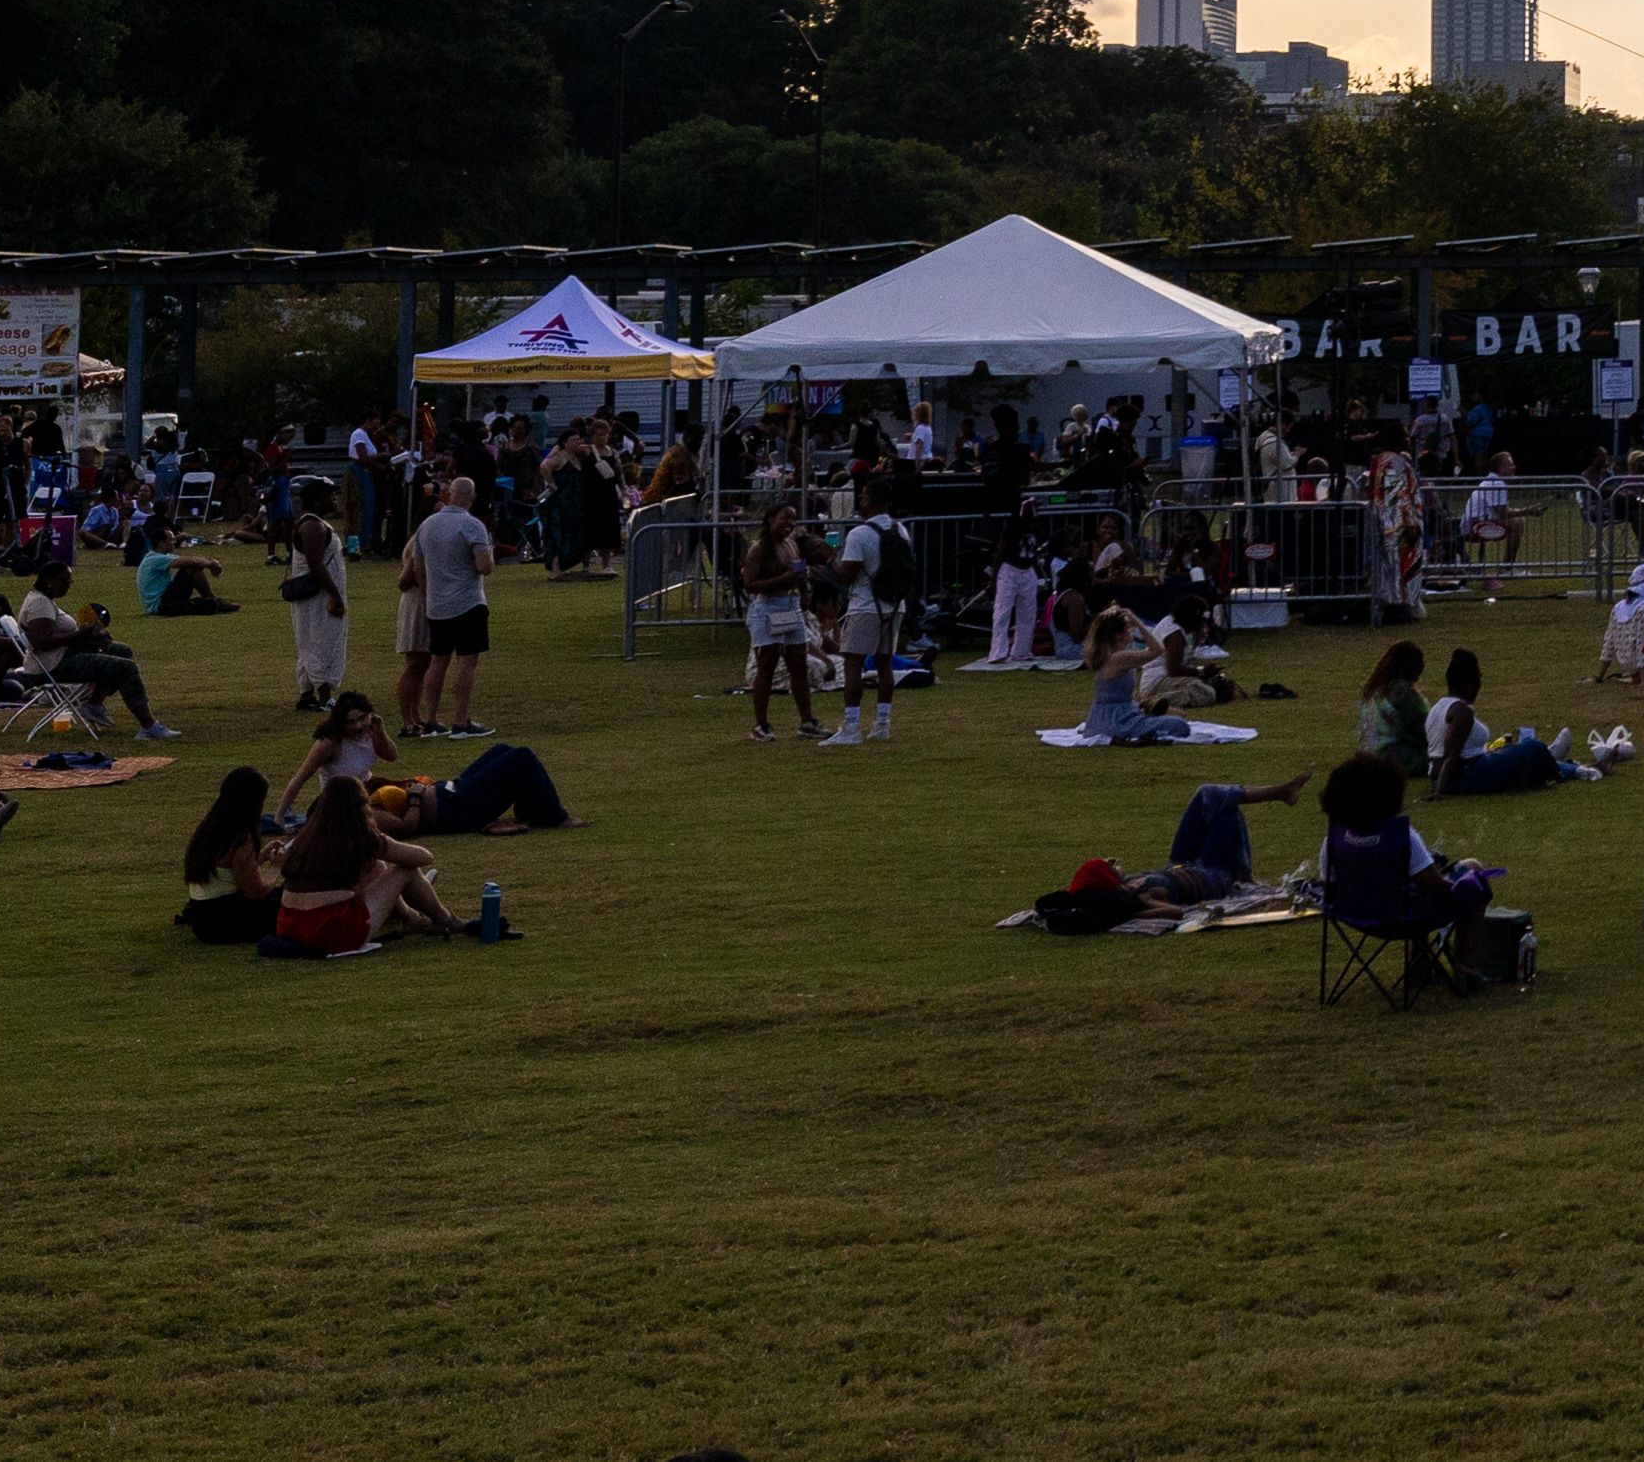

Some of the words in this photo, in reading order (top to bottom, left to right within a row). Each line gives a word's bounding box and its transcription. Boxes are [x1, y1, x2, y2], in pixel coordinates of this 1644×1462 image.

[1476, 314, 1582, 355] BAR
[507, 341, 565, 349] THRIVING
[525, 347, 587, 355] TOGETHER
[473, 363, 611, 374] thrivingtogetheratlanta.org
[37, 383, 59, 395] Tea
[767, 386, 817, 404] ITALN
